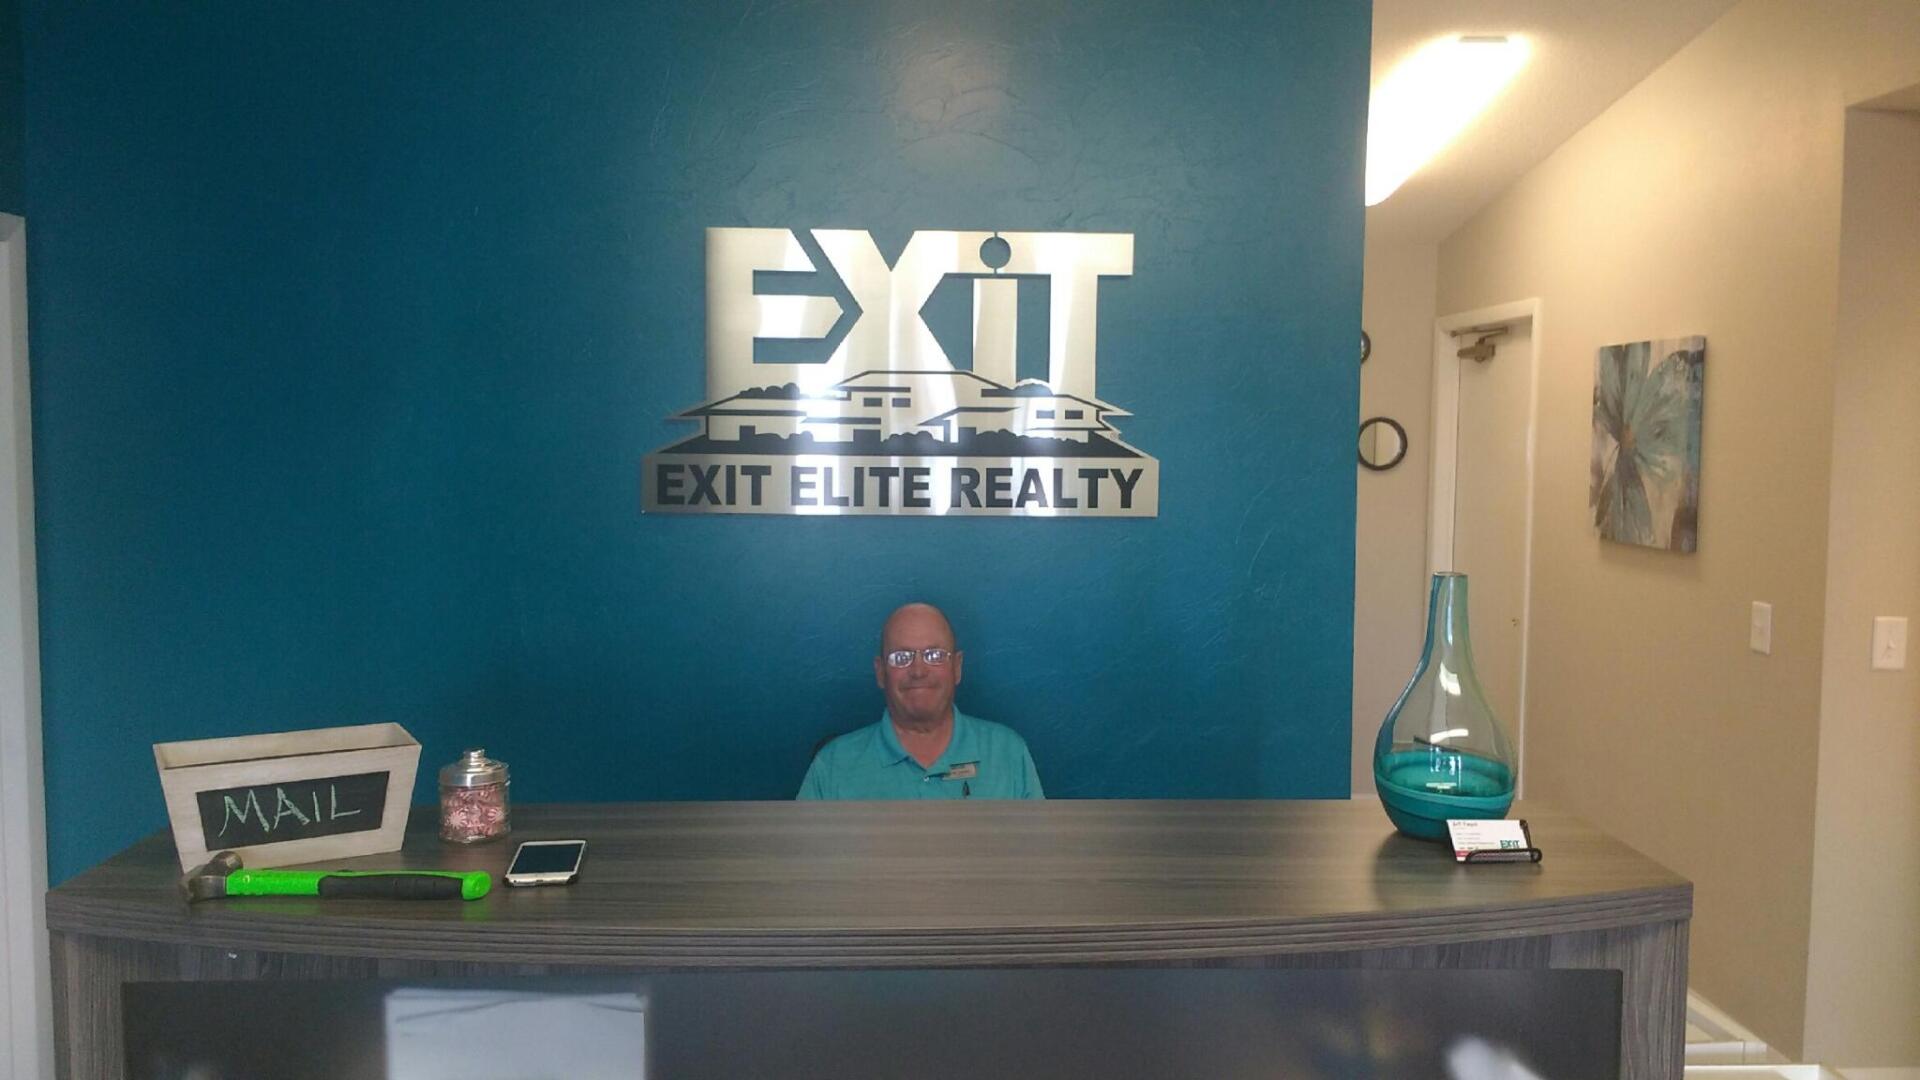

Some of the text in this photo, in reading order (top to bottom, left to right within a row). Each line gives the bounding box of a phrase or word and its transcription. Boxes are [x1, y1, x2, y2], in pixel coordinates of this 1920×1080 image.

[657, 465, 1143, 509] EXIT ELITE REALTY
[218, 784, 361, 838] MAIL
